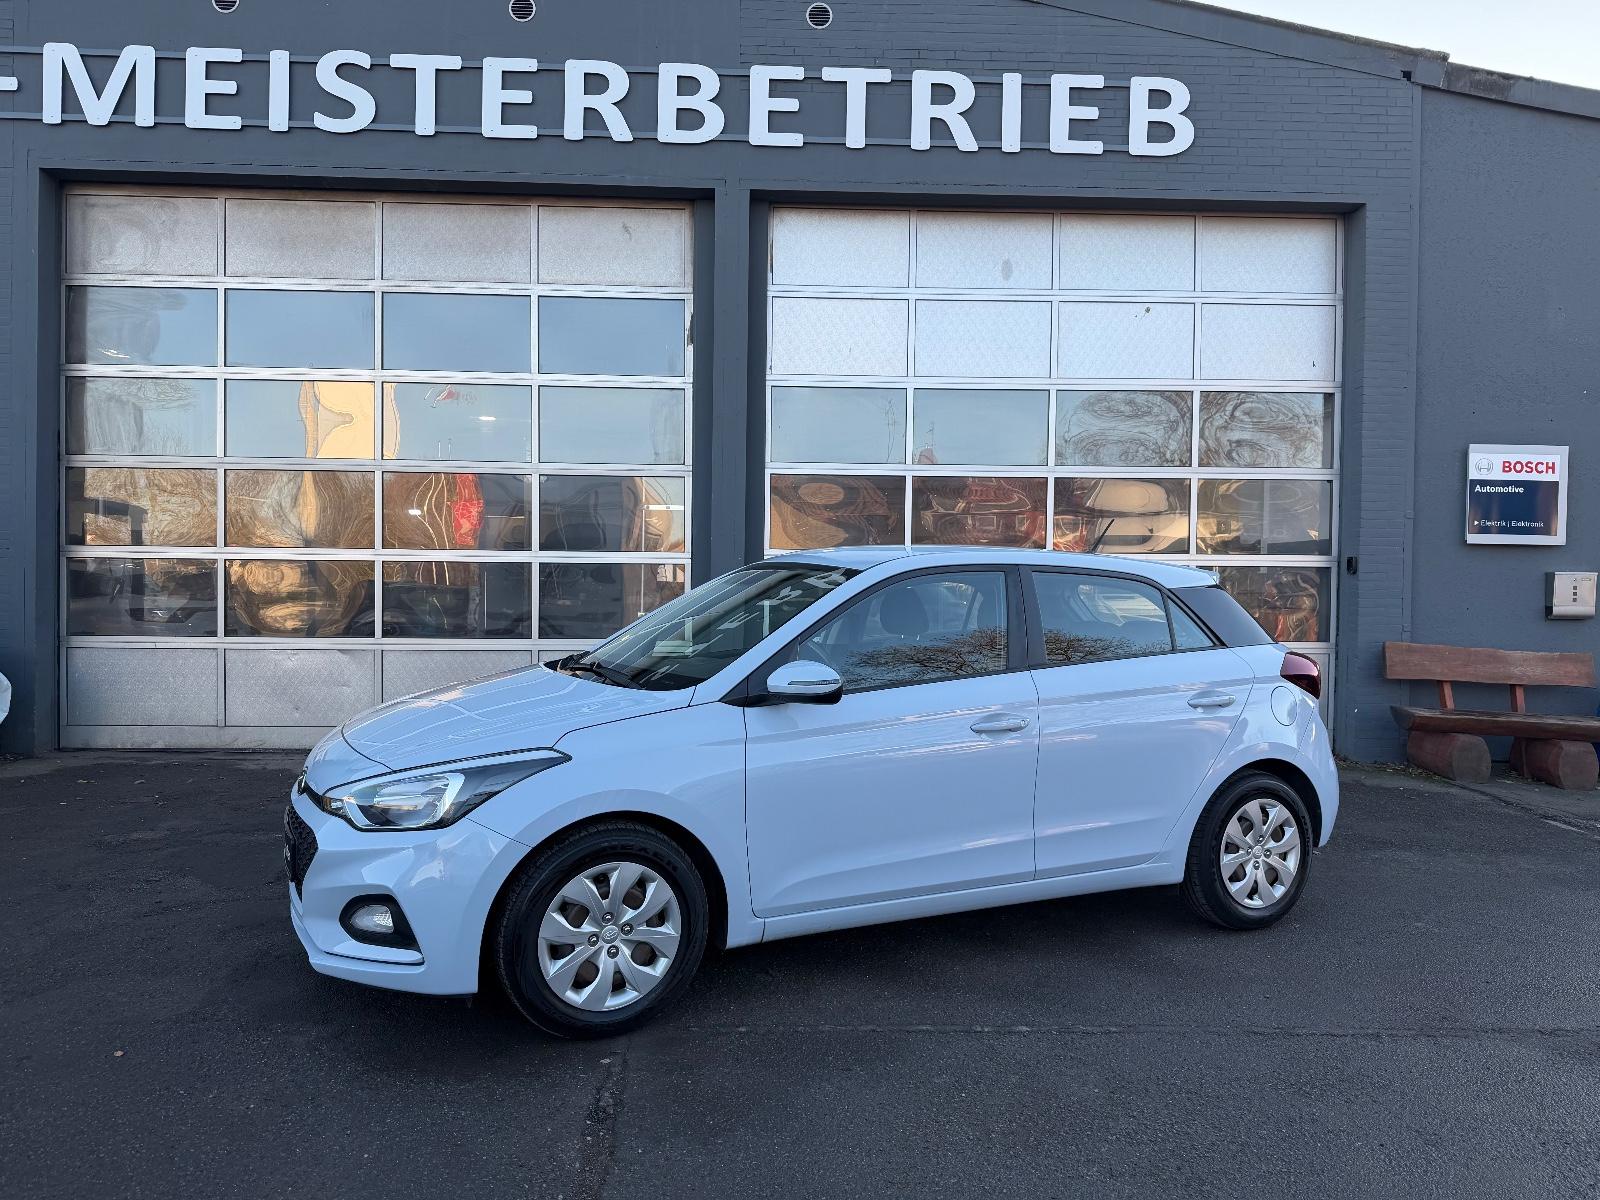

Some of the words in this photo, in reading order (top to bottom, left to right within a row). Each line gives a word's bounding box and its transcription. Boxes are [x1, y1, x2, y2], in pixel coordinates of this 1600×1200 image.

[1502, 460, 1556, 474] BOSCH
[1474, 485, 1525, 493] Automotive
[1480, 519, 1506, 527] Elektrik
[1511, 520, 1544, 528] Elektronik
